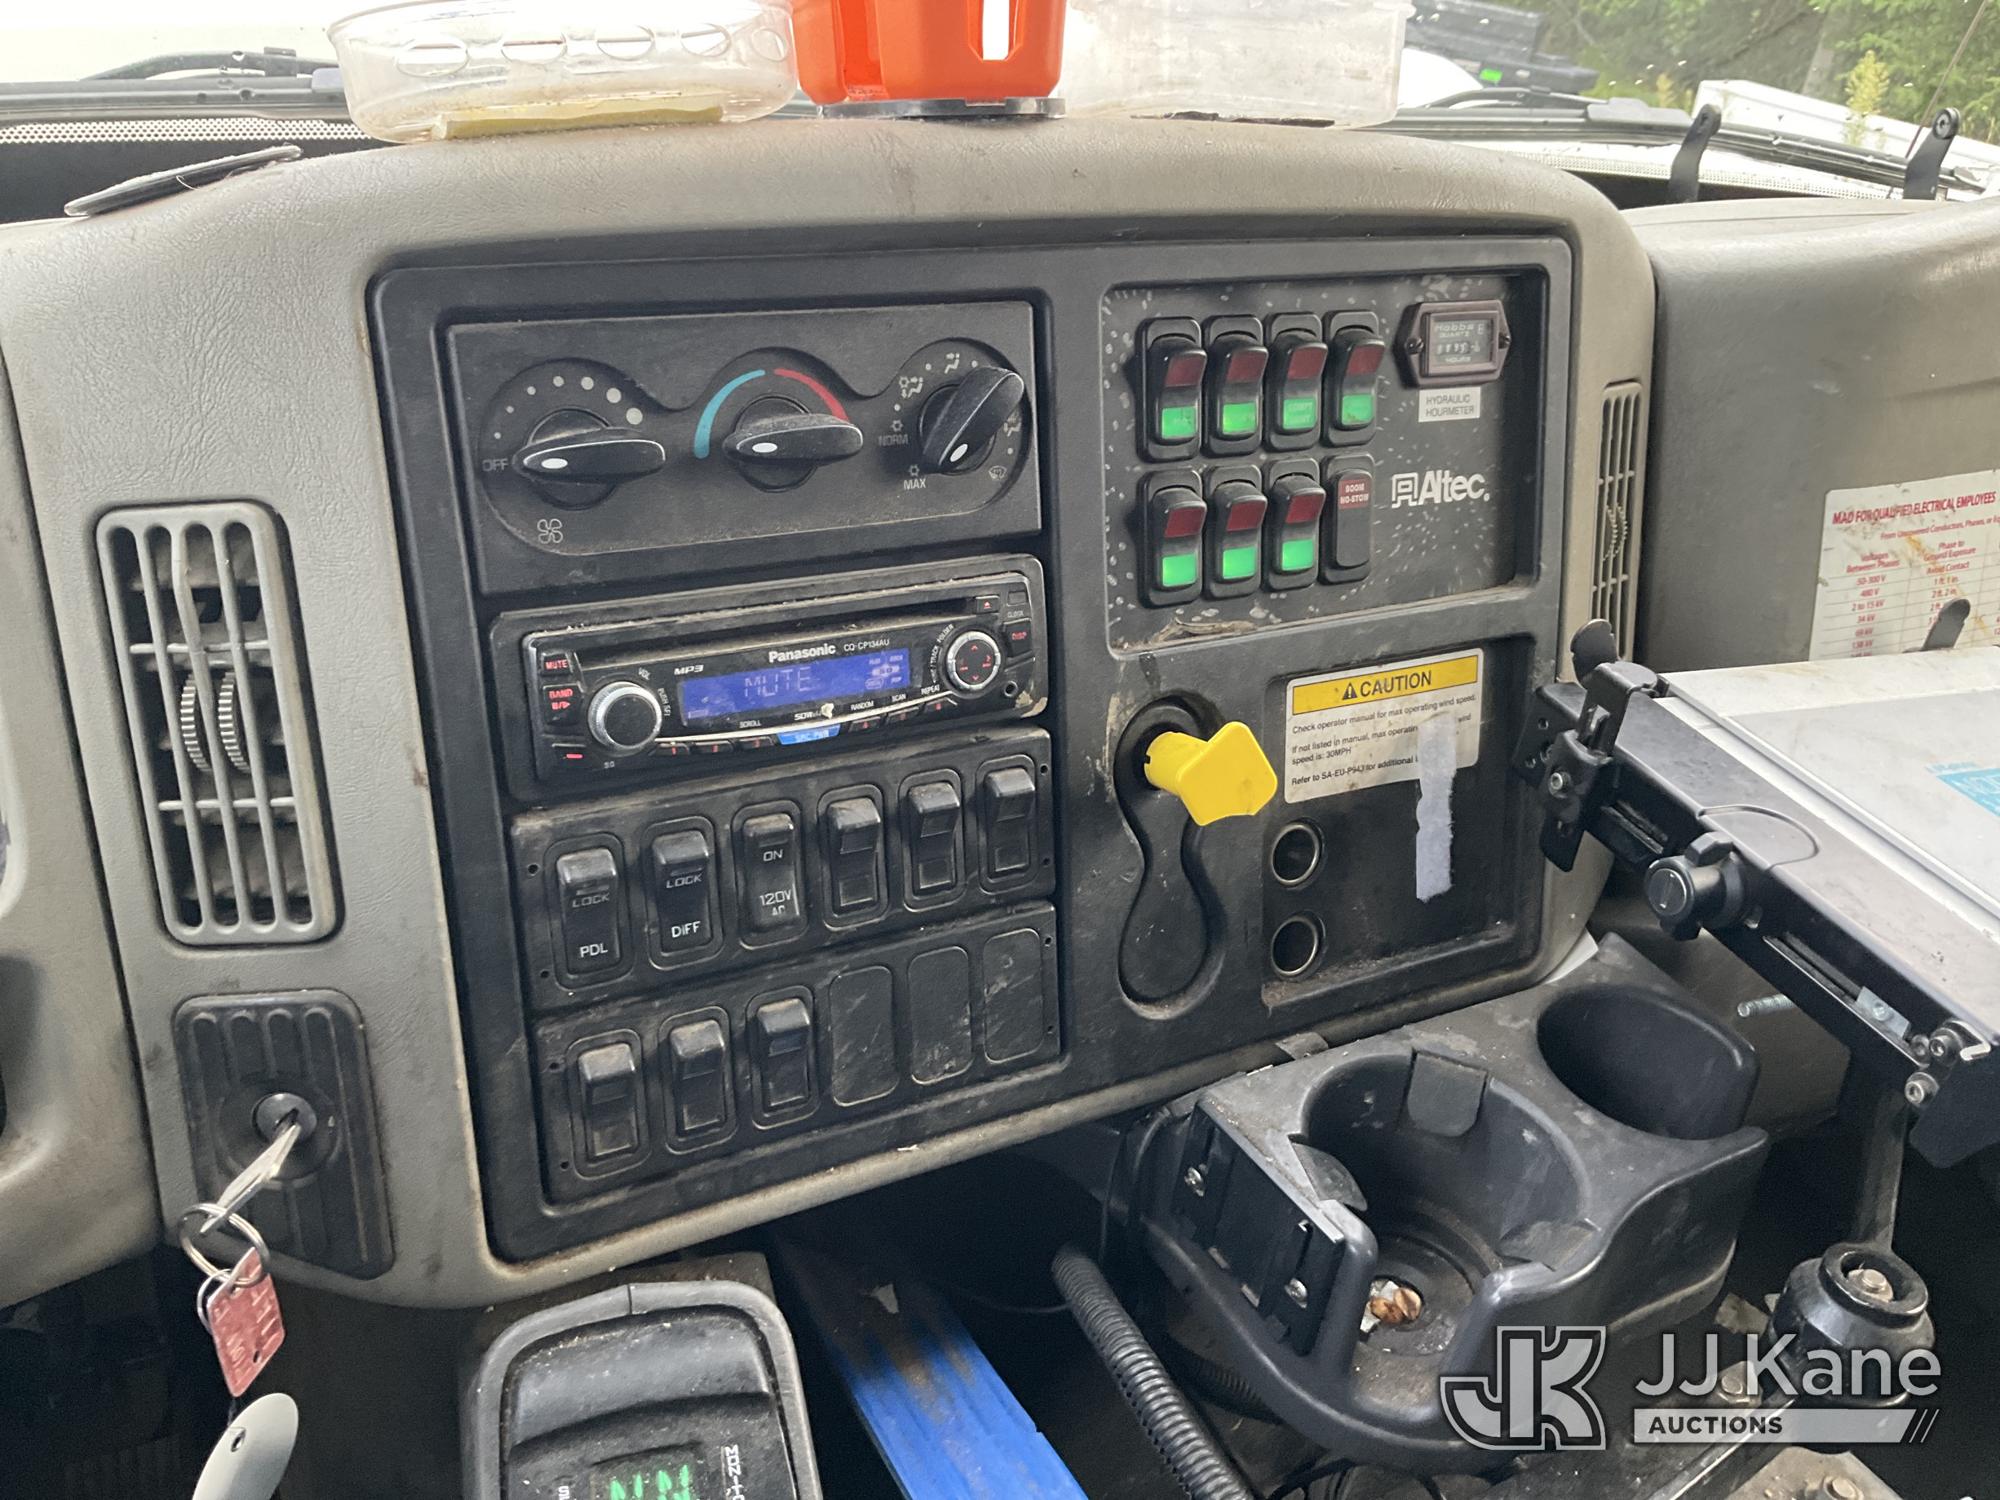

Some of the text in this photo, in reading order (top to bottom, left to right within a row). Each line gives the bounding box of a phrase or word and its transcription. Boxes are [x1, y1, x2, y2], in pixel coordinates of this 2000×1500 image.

[1425, 394, 1471, 405] HYDRAULIC
[1425, 405, 1475, 417] HOURMETER
[878, 433, 909, 446] NORM
[482, 458, 508, 472] OFF
[903, 478, 927, 490] MAX
[1345, 483, 1365, 493] BOOM
[1832, 491, 1997, 524] MAD FOR QUALIFIED ELECTRICAL EMPLOYEES
[1946, 561, 1969, 572] Contact
[768, 643, 837, 664] Panasonic
[545, 660, 568, 670] MUTE
[674, 664, 704, 676] MP3
[743, 665, 812, 699] MUTE
[1360, 669, 1432, 698] CAUTION
[549, 688, 574, 700] BAND
[920, 684, 941, 696] REPEAT
[850, 700, 875, 711] RANDOM
[1293, 721, 1315, 734] Check
[1316, 718, 1348, 733] operator
[1349, 712, 1375, 724] manual
[1377, 711, 1387, 719] for
[1388, 709, 1403, 717] max
[1404, 702, 1438, 715] operating
[1439, 698, 1454, 708] wind
[740, 719, 762, 729] SCROLL
[1291, 745, 1297, 754] If
[1298, 743, 1311, 752] not
[1312, 739, 1332, 750] listed
[1333, 735, 1340, 746] in
[1371, 729, 1387, 738] max
[1388, 725, 1418, 737] operatin
[1292, 754, 1314, 766] speed
[1326, 746, 1352, 759] 30MPH
[1292, 775, 1311, 786] Refer
[1312, 774, 1320, 782] to
[1377, 755, 1414, 768] additional
[763, 848, 784, 863] ON
[666, 872, 703, 889] LOCK
[571, 892, 610, 908] LOCK
[759, 889, 792, 906] 120V
[671, 920, 701, 938] DIFF
[580, 943, 608, 957] PDL
